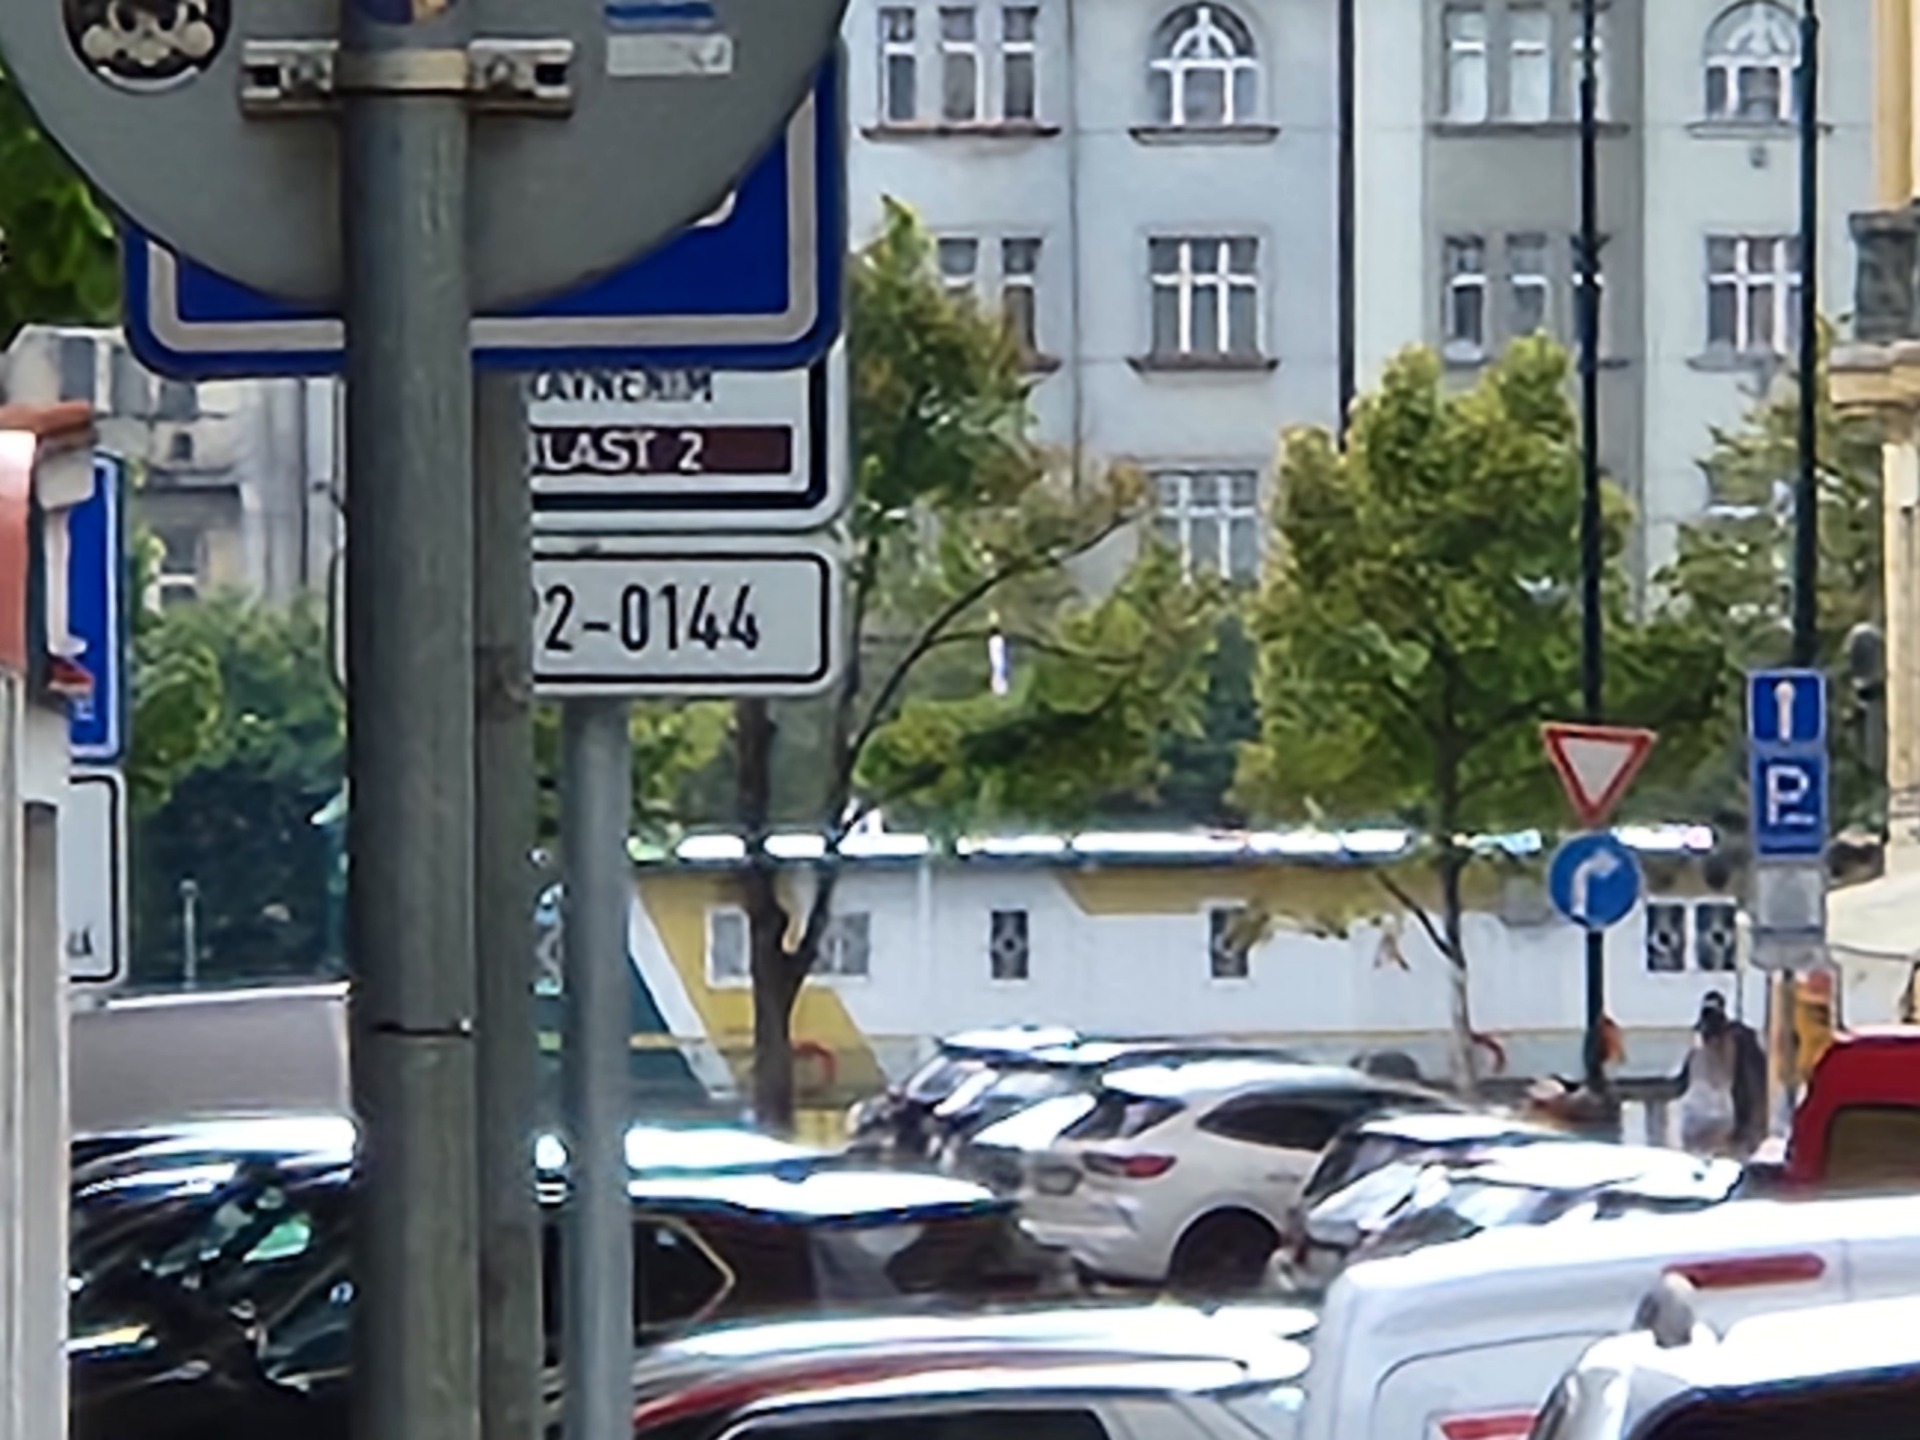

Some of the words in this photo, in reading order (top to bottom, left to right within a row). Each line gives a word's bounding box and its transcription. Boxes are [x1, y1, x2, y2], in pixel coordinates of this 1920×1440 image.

[678, 430, 703, 471] 2
[533, 584, 760, 652] 2-0144
[1765, 764, 1809, 825] P
